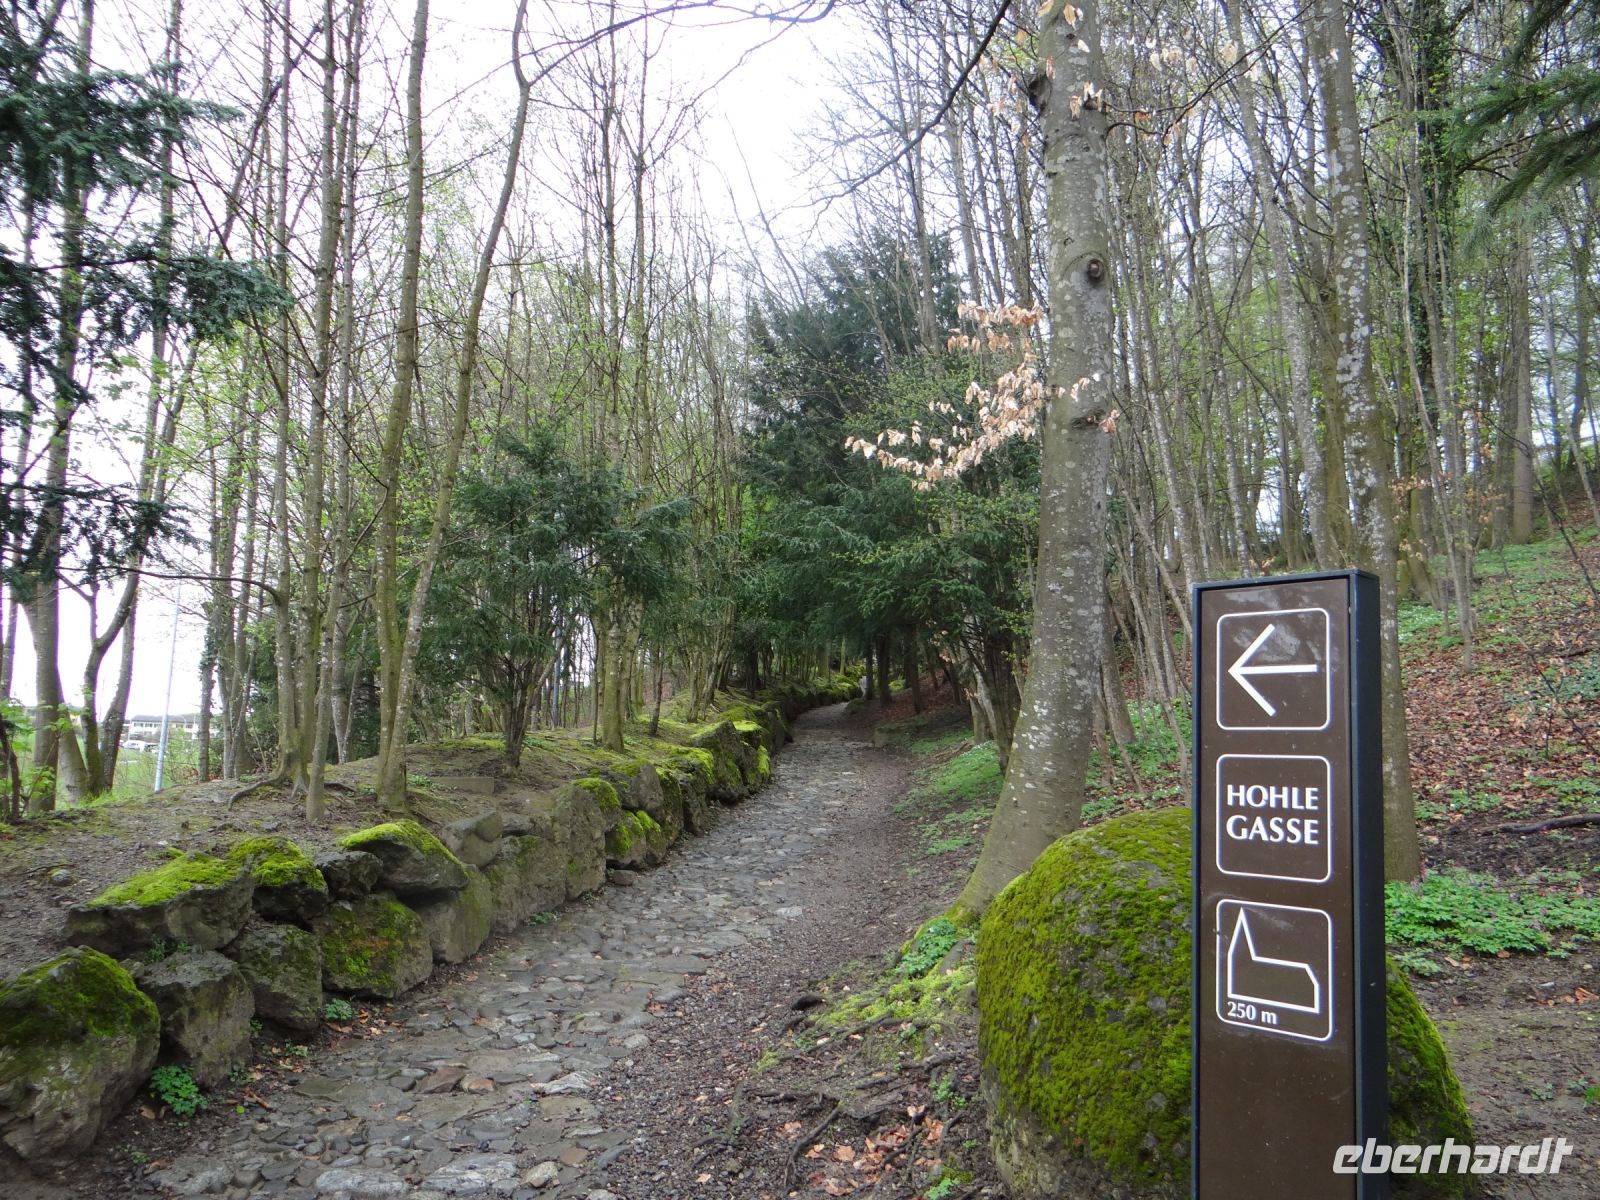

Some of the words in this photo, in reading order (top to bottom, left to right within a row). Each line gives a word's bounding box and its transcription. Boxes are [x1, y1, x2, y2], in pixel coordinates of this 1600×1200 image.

[1226, 784, 1319, 810] HOHLE
[1226, 815, 1319, 844] GASSE
[1227, 1001, 1256, 1021] 250
[1261, 1010, 1278, 1025] m
